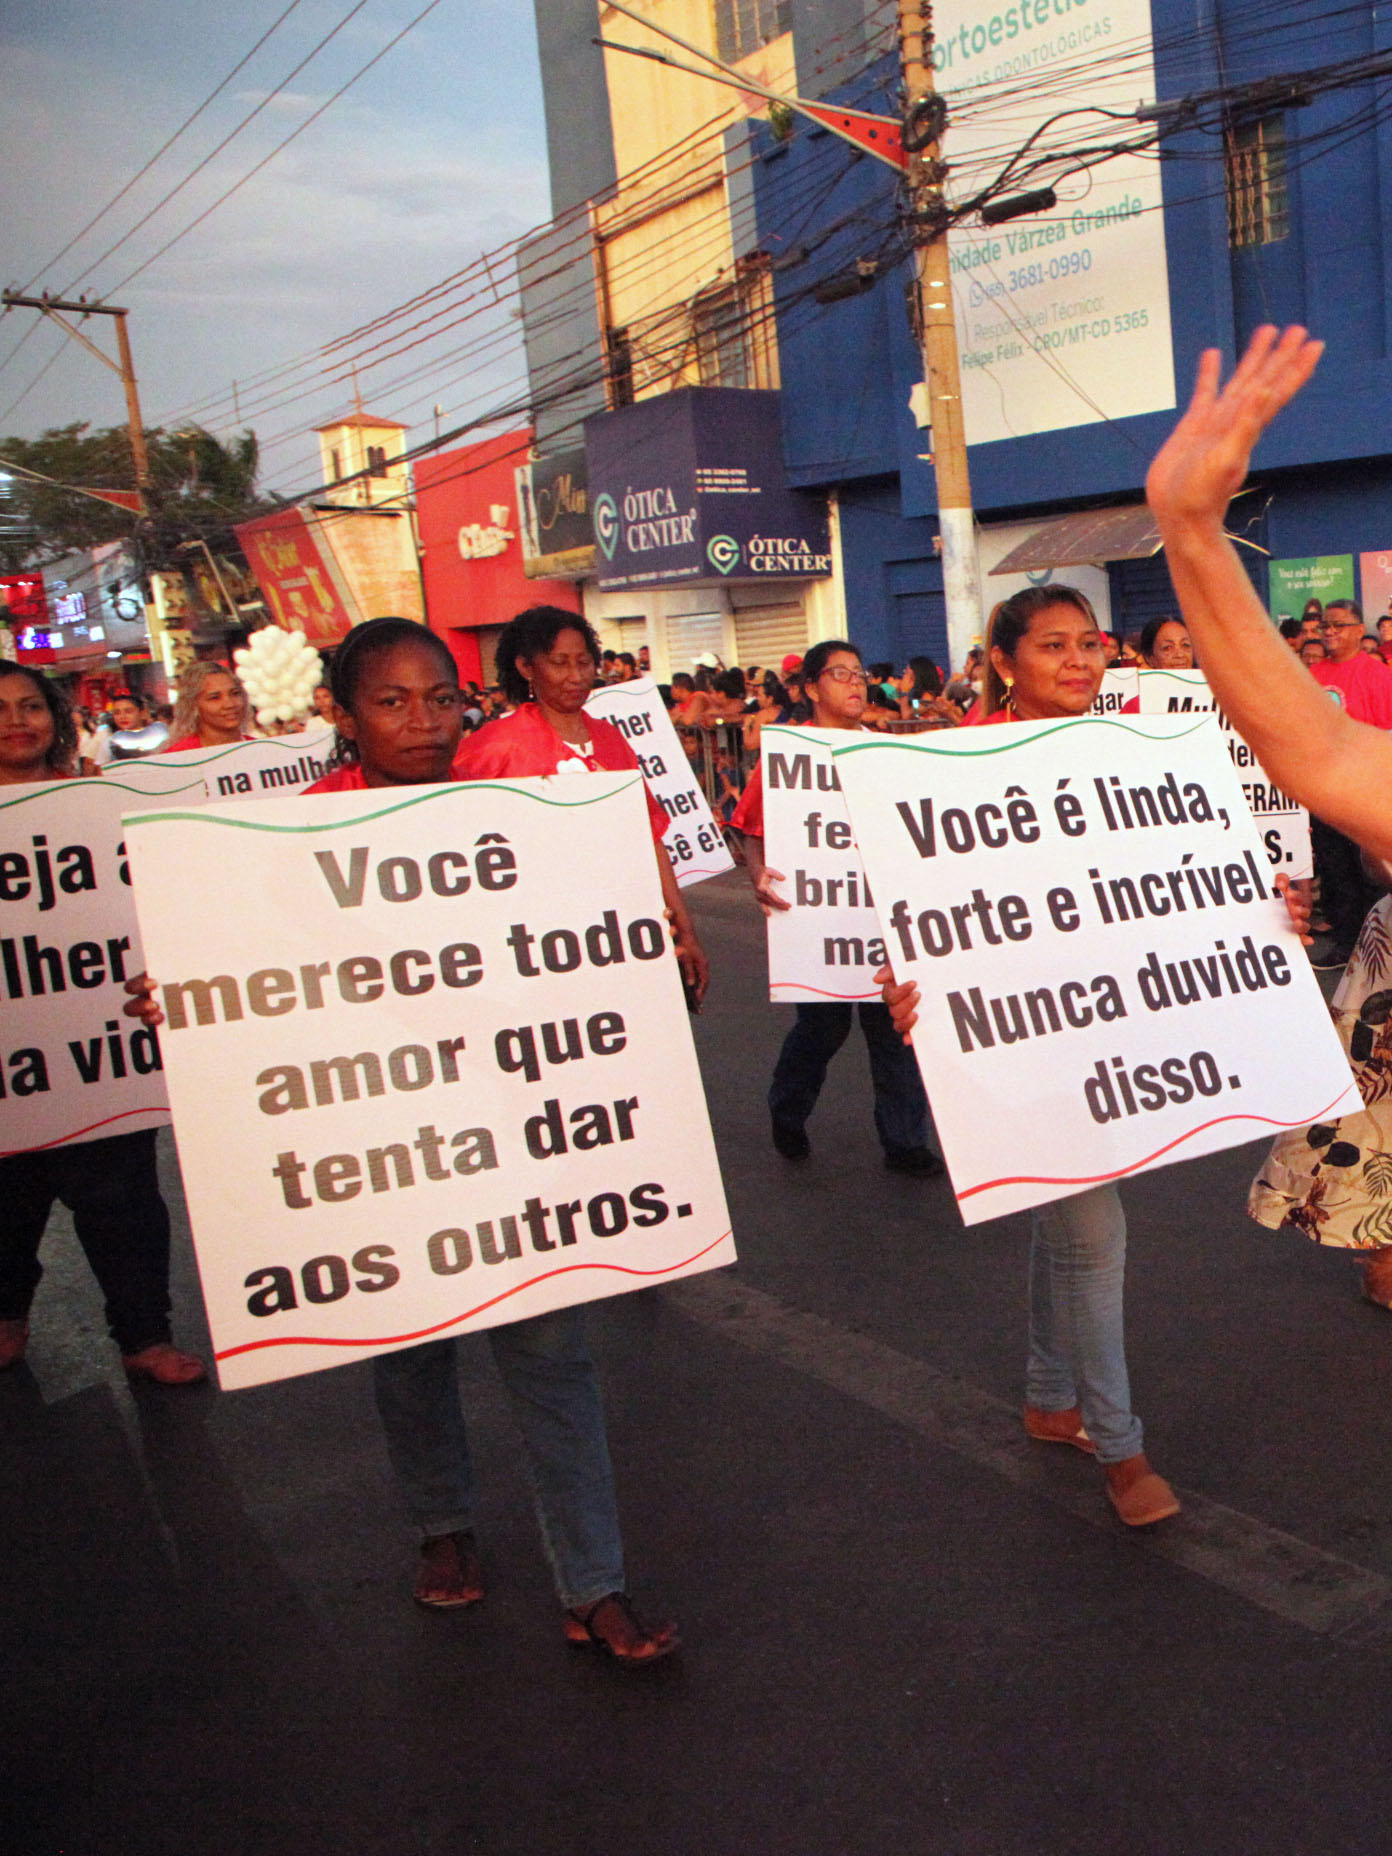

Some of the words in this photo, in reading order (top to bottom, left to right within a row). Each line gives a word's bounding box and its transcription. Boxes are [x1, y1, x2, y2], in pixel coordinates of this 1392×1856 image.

[950, 238, 1002, 275] nidade
[1071, 193, 1143, 236] Grande
[1008, 248, 1092, 293] 3681-0990
[1114, 309, 1149, 334] 5365
[623, 485, 678, 522] ÓTICA
[626, 514, 696, 553] CENTER
[748, 533, 812, 555] ÓTICA
[750, 554, 830, 572] CENTER
[1092, 691, 1124, 715] gar
[217, 771, 253, 796] na
[637, 753, 668, 780] ta
[655, 788, 700, 818] her
[894, 785, 1041, 860] Você
[1053, 777, 1087, 837] é
[1093, 771, 1231, 832] linda,
[0, 834, 97, 912] eja
[313, 832, 519, 909] Você
[823, 936, 890, 967] ma
[890, 886, 1033, 963] forte
[1046, 883, 1081, 933] e
[0, 934, 131, 999] lher
[162, 939, 484, 1030] merece
[507, 909, 666, 978] todo
[946, 971, 1129, 1054] Nunca
[1136, 934, 1292, 1013] duvide
[68, 1018, 163, 1084] vid
[255, 1035, 466, 1116] amor
[494, 1008, 628, 1083] que
[1083, 1049, 1242, 1126] disso.
[272, 1124, 500, 1210] tenta
[523, 1095, 640, 1160] dar
[243, 1243, 400, 1318] aos
[425, 1182, 693, 1277] outros.
